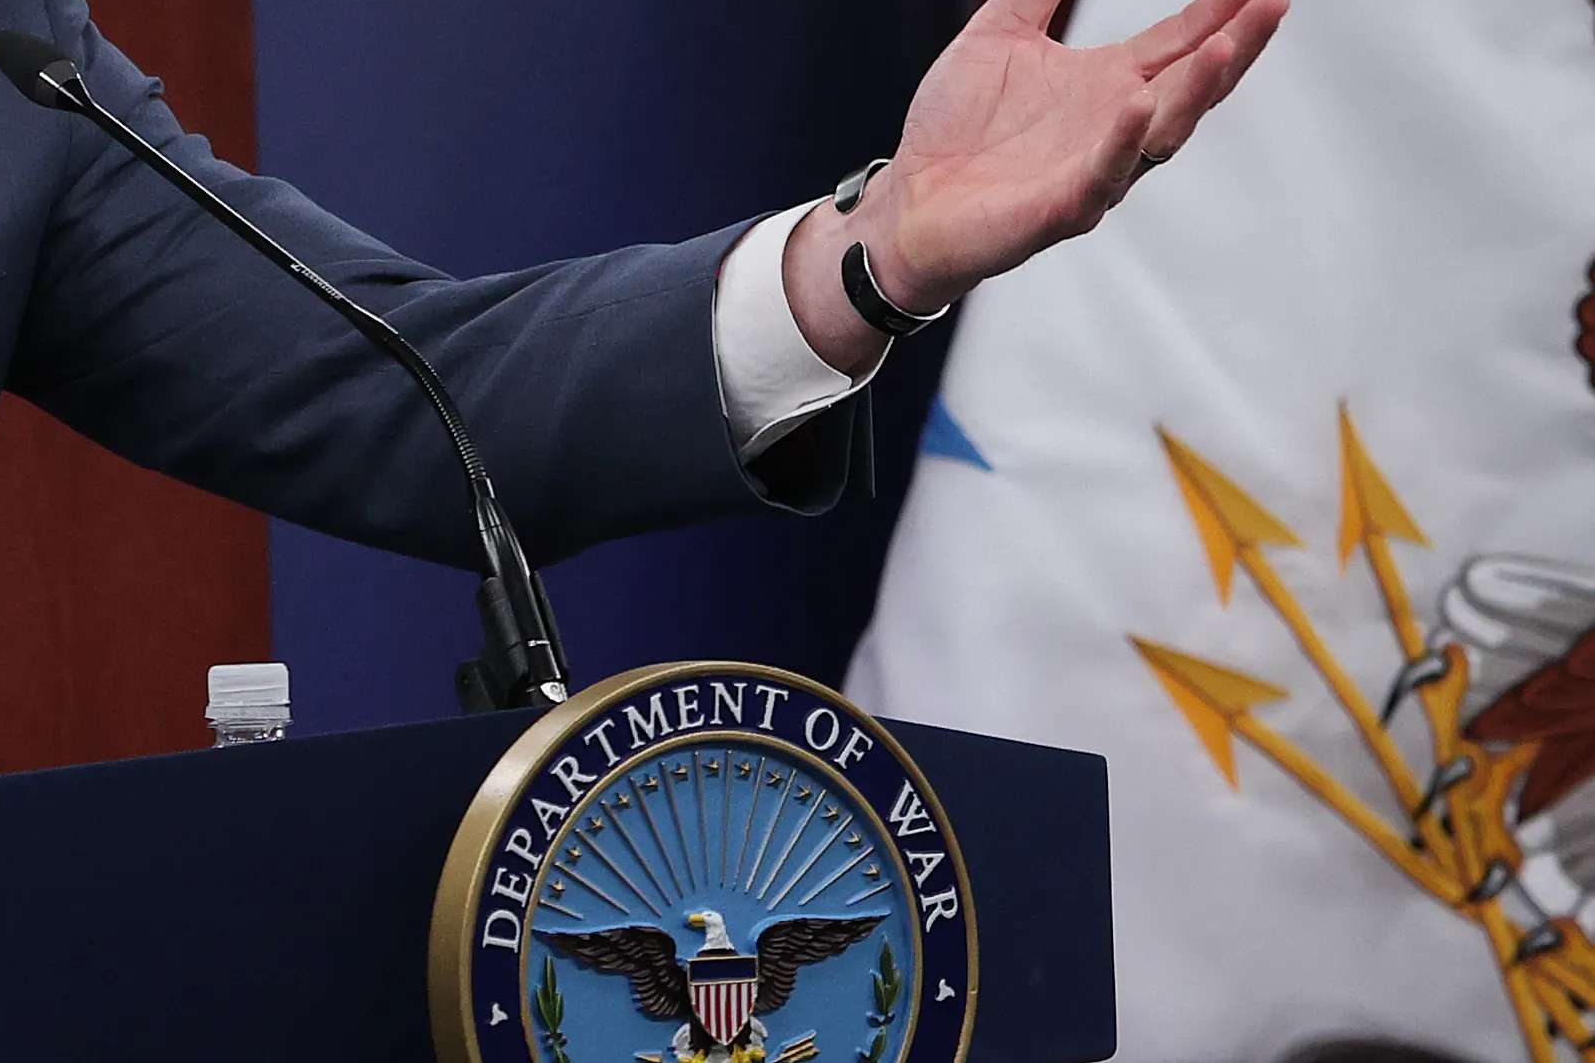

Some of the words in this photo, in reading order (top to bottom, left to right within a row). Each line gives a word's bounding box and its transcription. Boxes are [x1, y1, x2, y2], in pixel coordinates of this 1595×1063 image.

[482, 682, 789, 954] DEPARTMENT
[804, 707, 874, 770] OF
[886, 778, 959, 933] WAR
